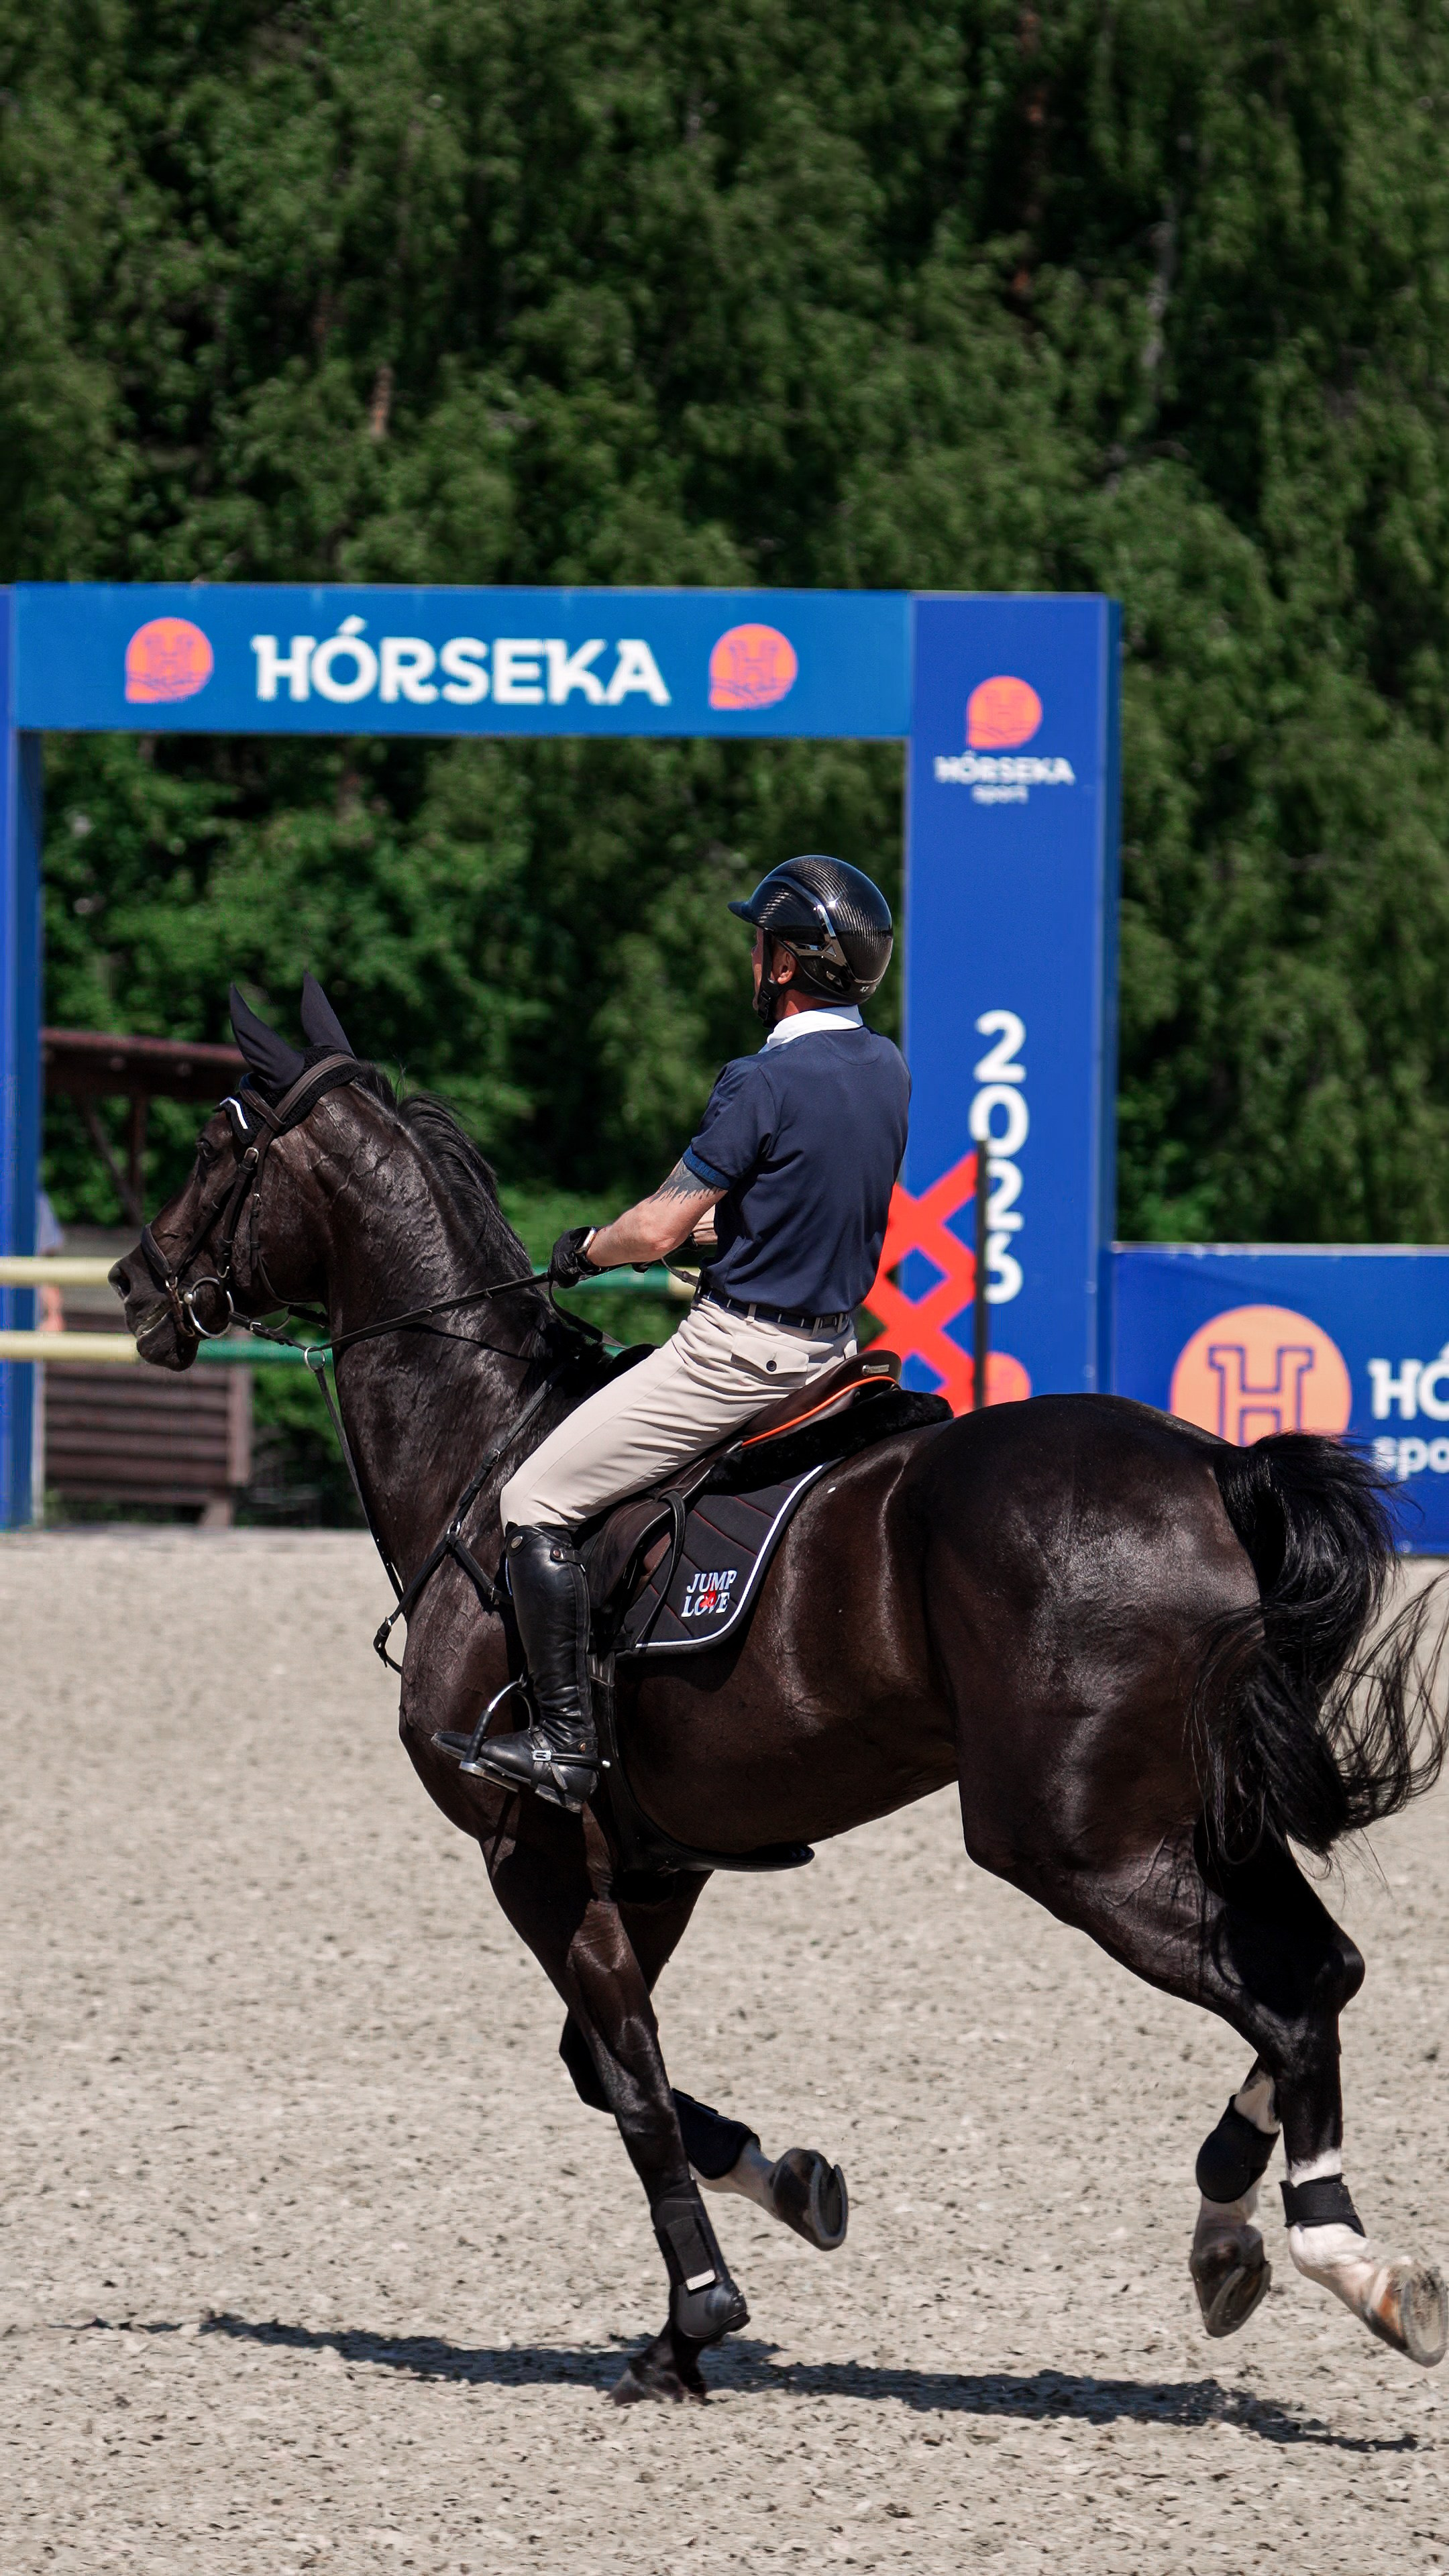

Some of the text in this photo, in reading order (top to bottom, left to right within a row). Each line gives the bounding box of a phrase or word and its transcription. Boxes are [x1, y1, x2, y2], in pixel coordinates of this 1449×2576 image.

[251, 615, 672, 706] HÓRSEKA
[934, 751, 1075, 786] HÓRSEKA
[968, 1009, 1029, 1304] 2025
[1208, 1345, 1313, 1448] H
[686, 1570, 737, 1593] JUMP
